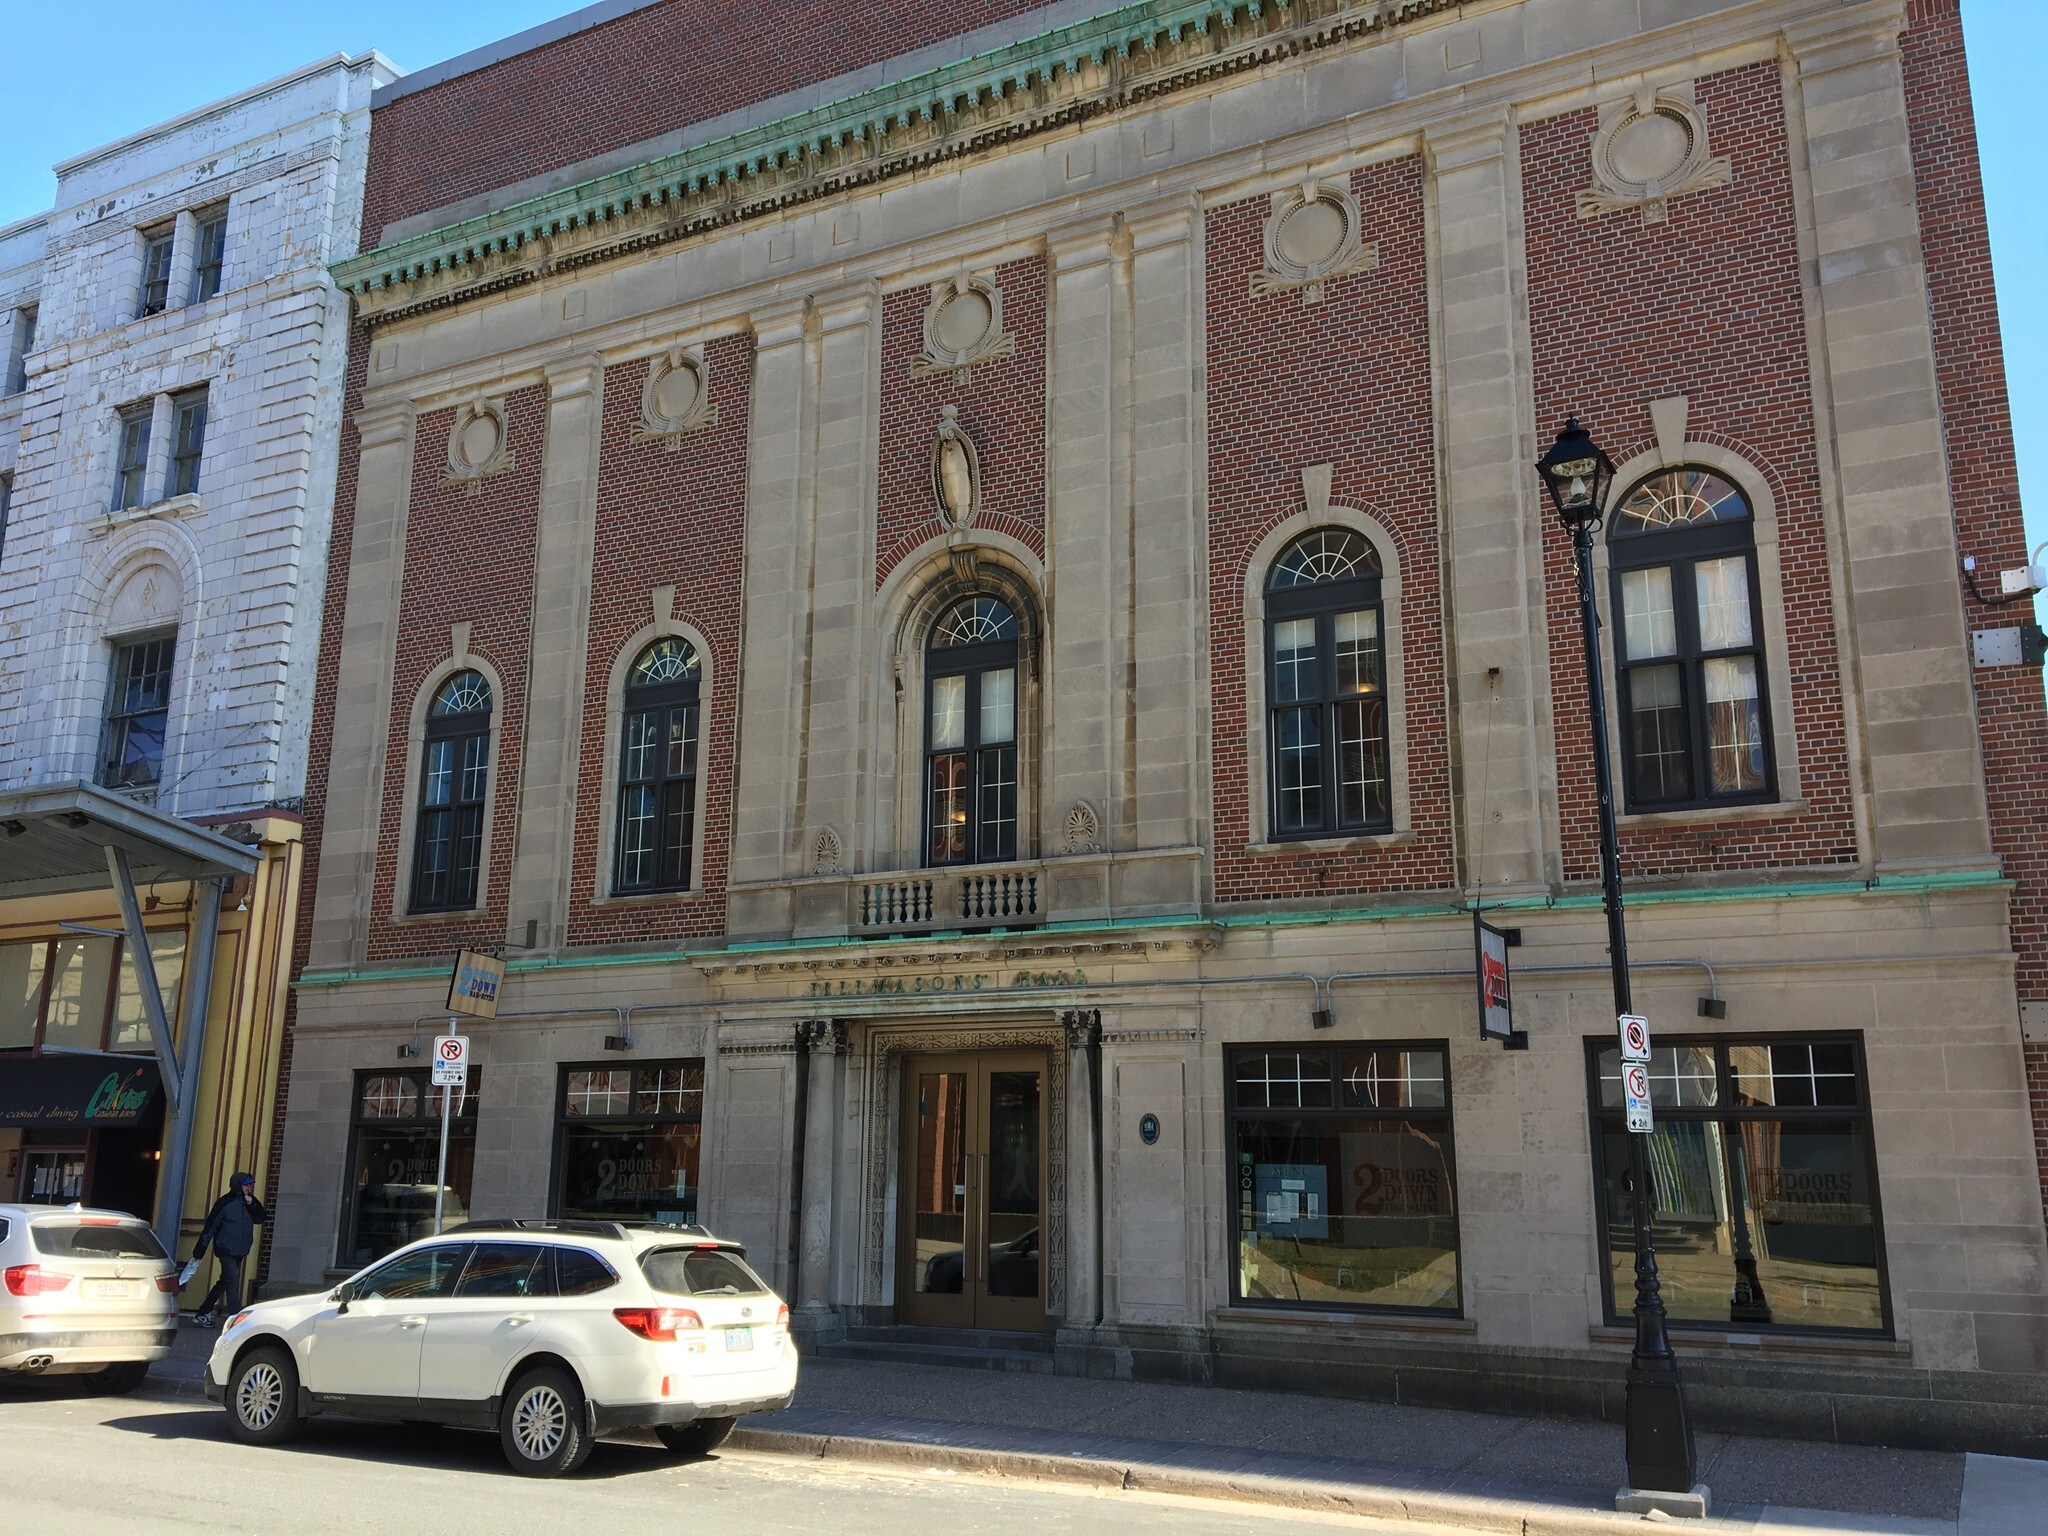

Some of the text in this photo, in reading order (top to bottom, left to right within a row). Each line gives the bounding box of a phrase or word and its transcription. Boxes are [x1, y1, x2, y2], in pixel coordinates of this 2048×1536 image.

[458, 965, 473, 996] 2
[474, 968, 499, 983] DOORS
[1016, 968, 1088, 987] HALL
[1483, 951, 1494, 1009] 2
[471, 979, 497, 995] DOWN
[6, 1105, 45, 1118] casual
[46, 1106, 79, 1121] dining
[407, 1158, 438, 1171] DOOR
[618, 1158, 662, 1173] DOORS
[1272, 1166, 1309, 1177] MENU
[597, 1158, 616, 1200] 2
[617, 1174, 660, 1189] DOWN
[1383, 1167, 1438, 1184] DOORS
[1784, 1173, 1852, 1191] DOORS
[1353, 1163, 1384, 1214] 2
[1384, 1184, 1439, 1202] DOWN
[1785, 1191, 1853, 1208] DOWN
